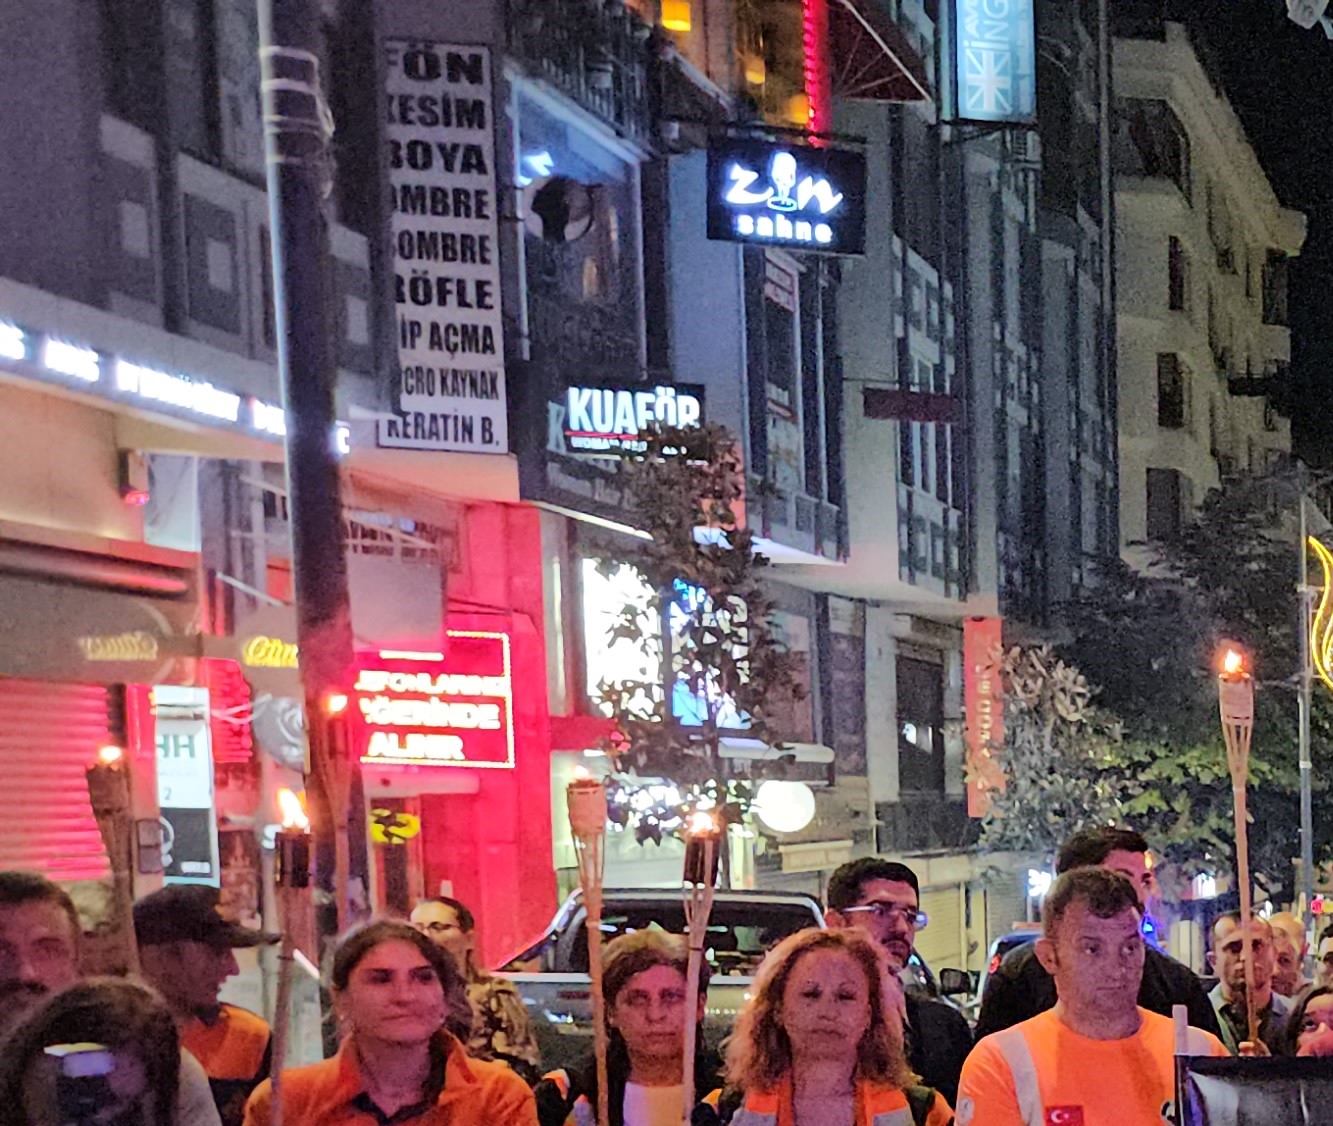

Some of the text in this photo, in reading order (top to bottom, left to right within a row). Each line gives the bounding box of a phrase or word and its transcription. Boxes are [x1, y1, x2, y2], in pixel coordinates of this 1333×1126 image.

[429, 318, 495, 360] AÇMA
[440, 368, 499, 401] KAYNAK
[388, 408, 474, 446] KERATİN
[481, 415, 500, 447] B.
[568, 386, 700, 434] KUAFÖR
